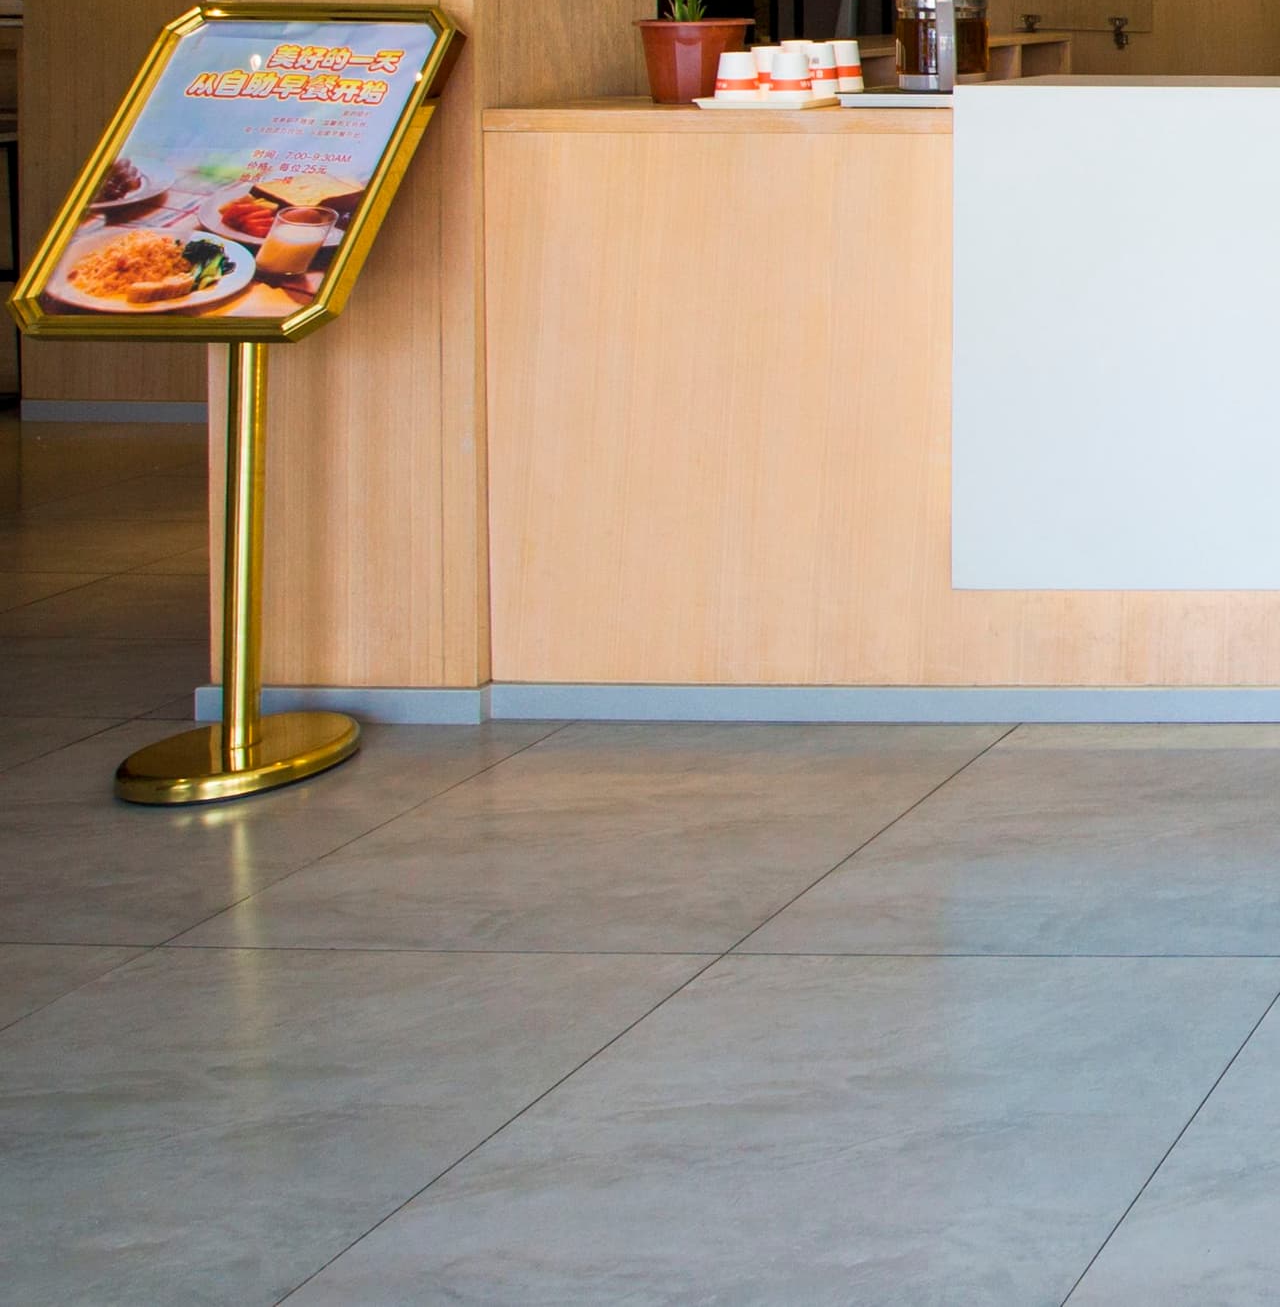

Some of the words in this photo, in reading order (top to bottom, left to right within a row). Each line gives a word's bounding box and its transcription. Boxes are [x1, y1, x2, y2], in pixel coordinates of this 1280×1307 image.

[266, 44, 405, 74] 美好的一天
[185, 70, 389, 105] 从自助早餐开始
